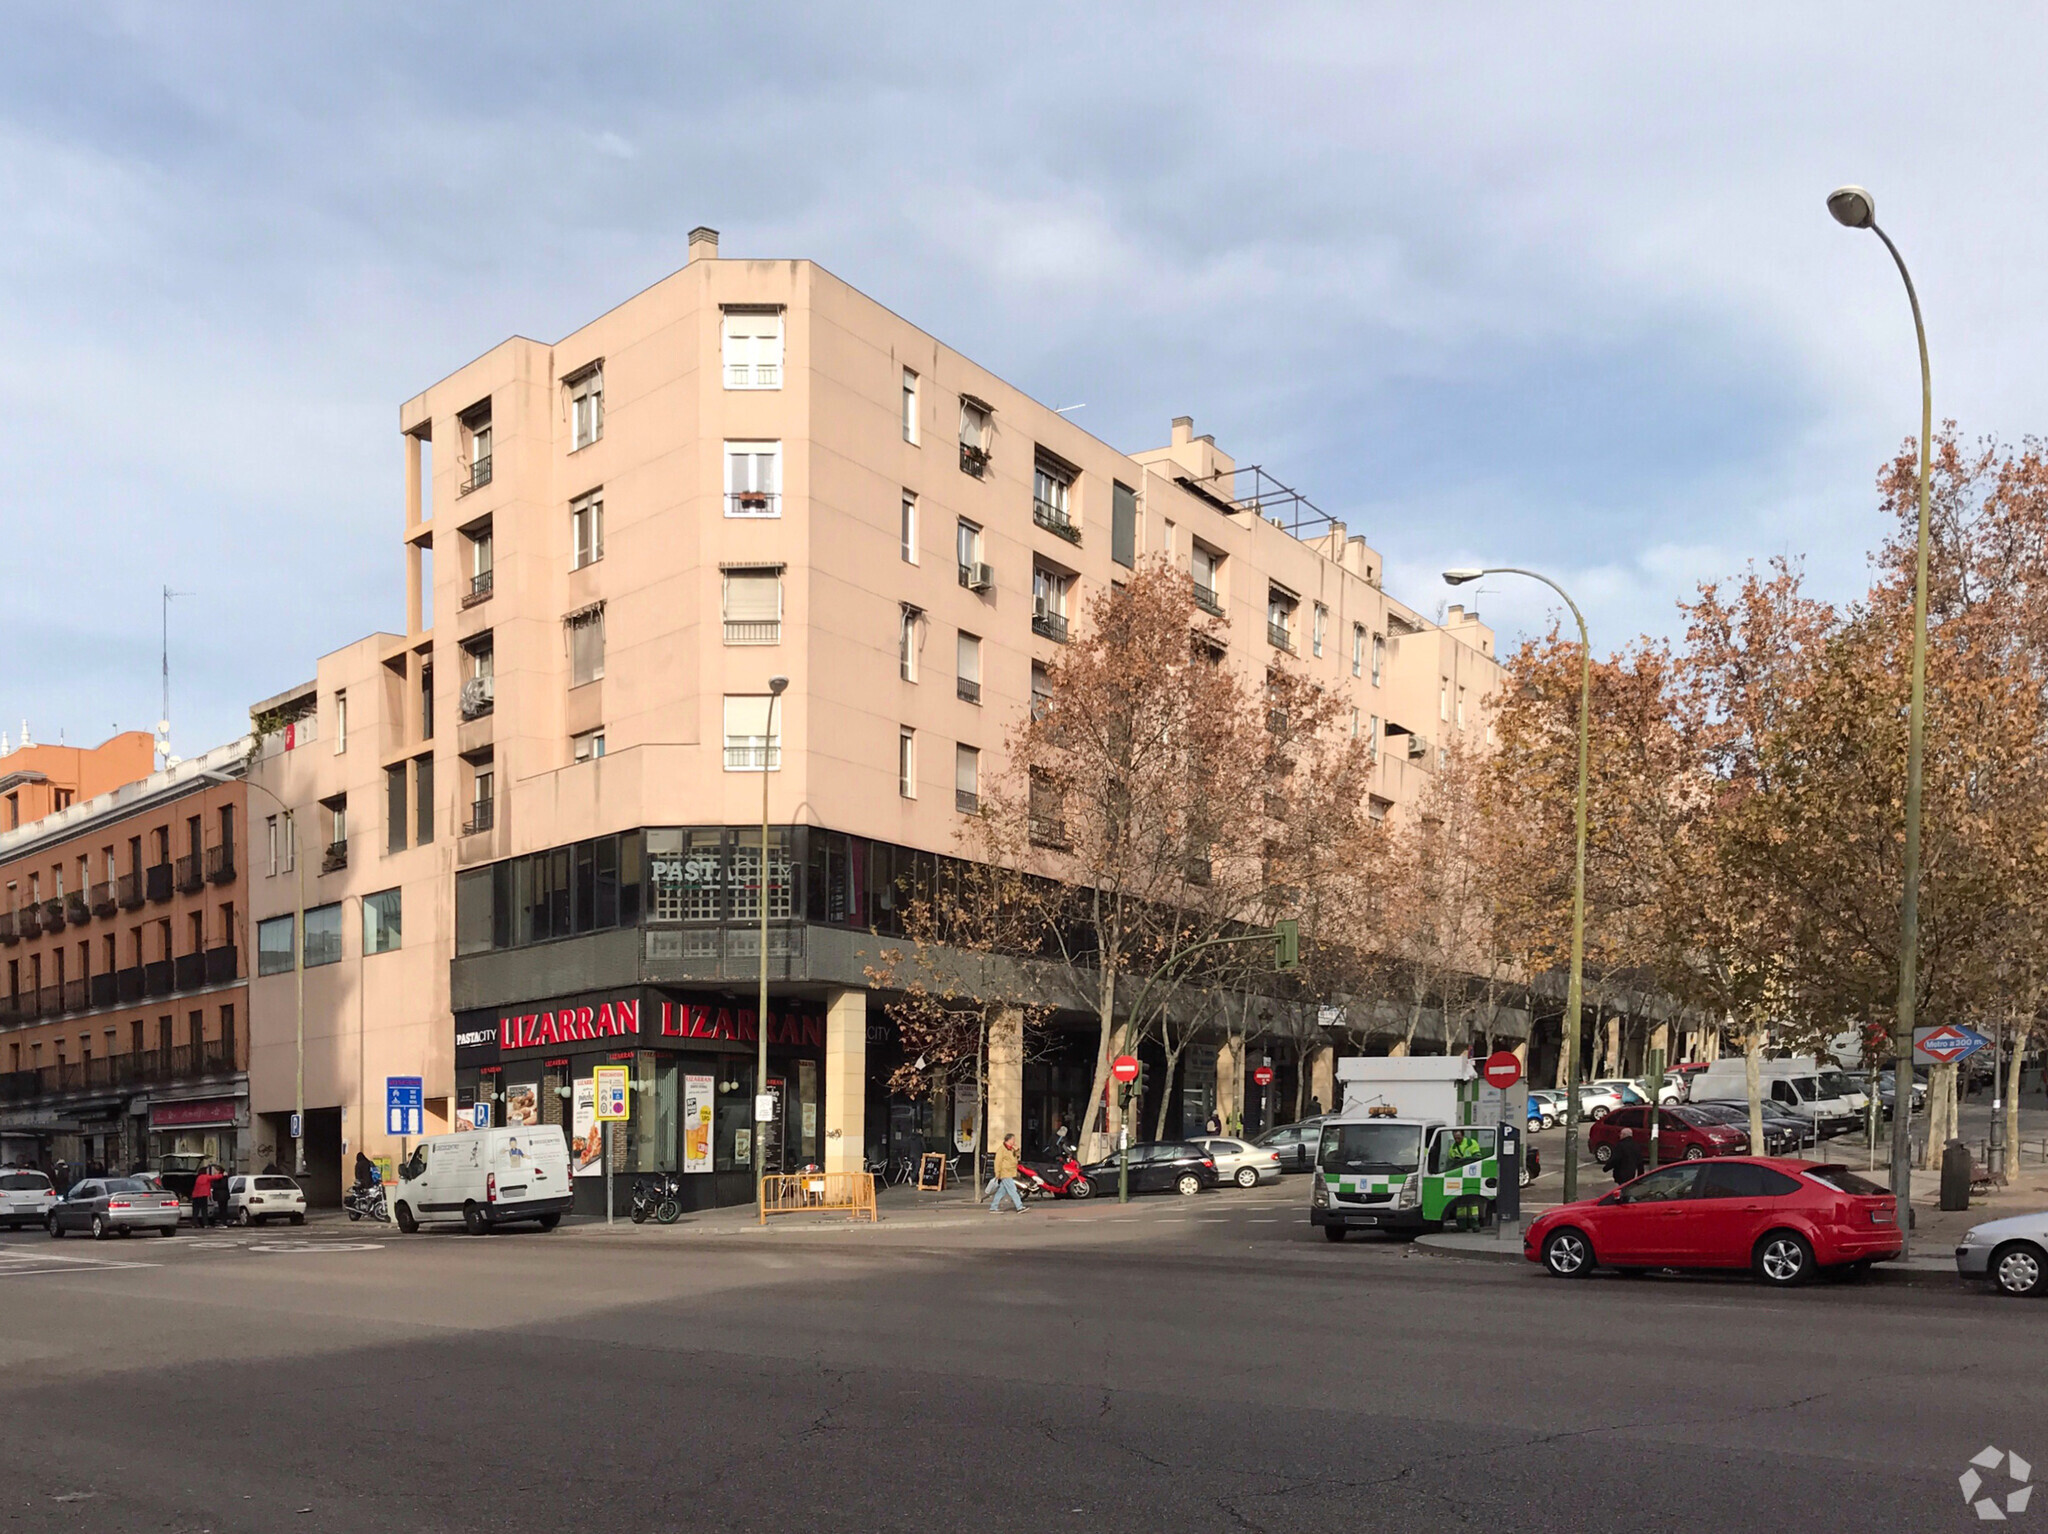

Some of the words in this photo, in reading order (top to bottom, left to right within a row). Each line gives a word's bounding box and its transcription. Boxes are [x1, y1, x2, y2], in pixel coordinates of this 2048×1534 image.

[500, 998, 640, 1050] LIZARRAN
[456, 1028, 498, 1046] PASTACITY
[1926, 1040, 1949, 1049] Metro
[478, 1105, 485, 1123] P
[1504, 1126, 1513, 1137] P
